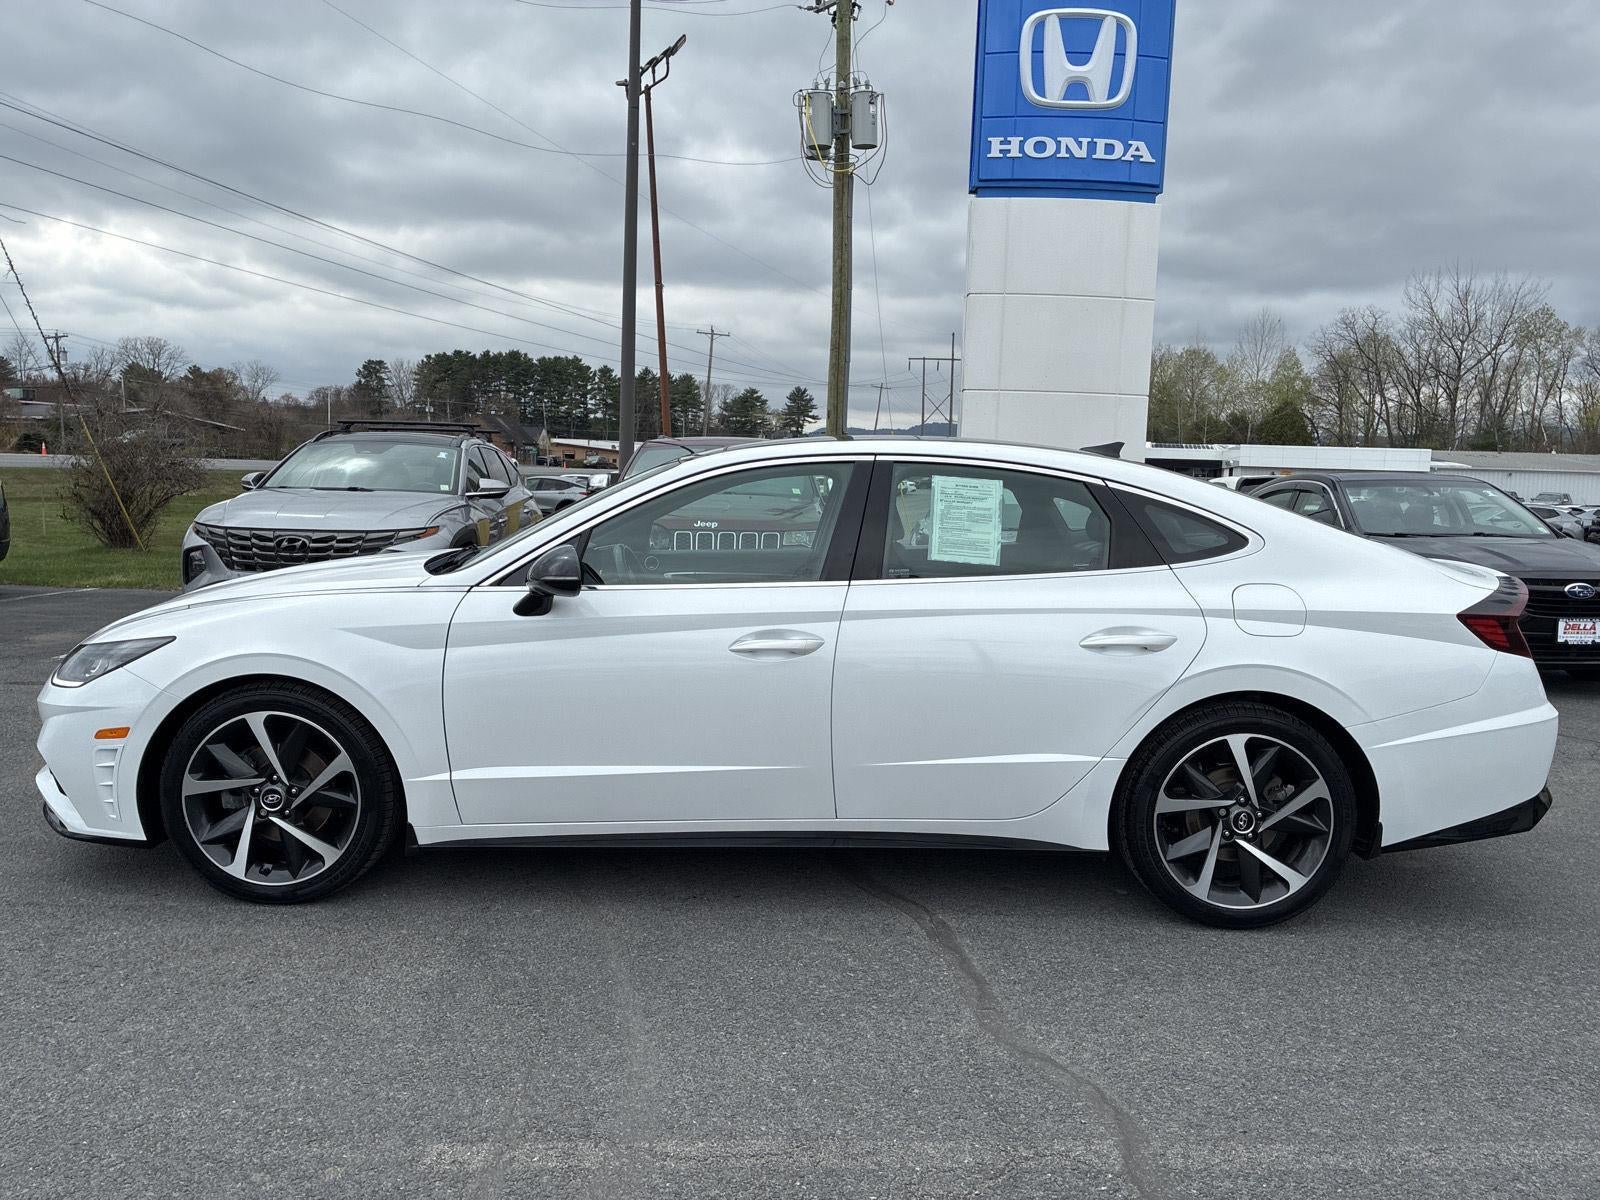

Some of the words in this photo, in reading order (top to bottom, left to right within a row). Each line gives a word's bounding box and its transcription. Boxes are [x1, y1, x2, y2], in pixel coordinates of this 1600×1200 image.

[986, 136, 1156, 163] HONDA
[693, 520, 718, 528] Jeep
[1563, 623, 1597, 631] DELLA
